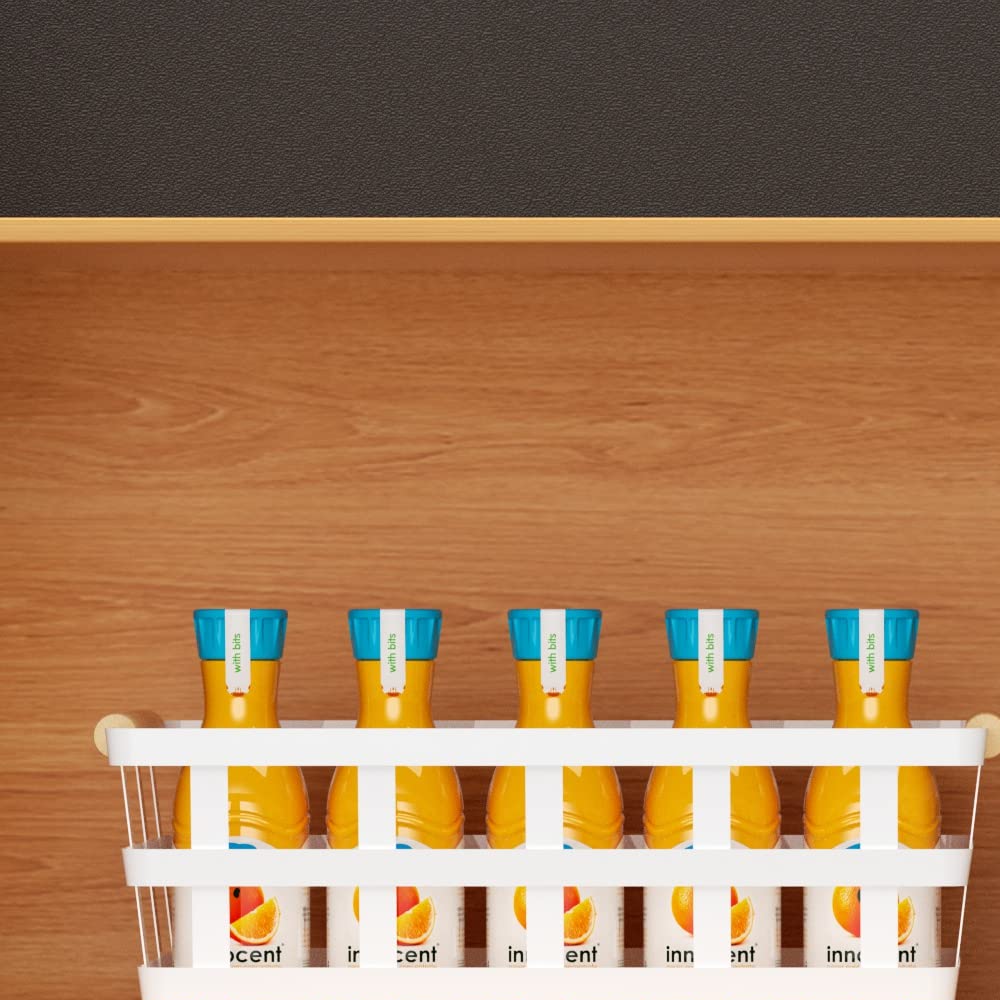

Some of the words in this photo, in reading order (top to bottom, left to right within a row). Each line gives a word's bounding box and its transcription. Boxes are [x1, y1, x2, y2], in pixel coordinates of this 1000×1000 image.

[232, 632, 241, 650] bits
[387, 632, 396, 650] bits
[549, 632, 558, 650] bits
[705, 632, 714, 650] bits
[866, 632, 875, 650] bits
[232, 653, 241, 673] with
[387, 653, 396, 673] with
[549, 653, 558, 673] with
[705, 653, 714, 673] with
[866, 653, 875, 673] with
[230, 945, 282, 963] cent
[347, 945, 438, 963] inent
[508, 945, 598, 963] inent
[665, 945, 756, 963] innnt
[826, 945, 917, 963] innnt
